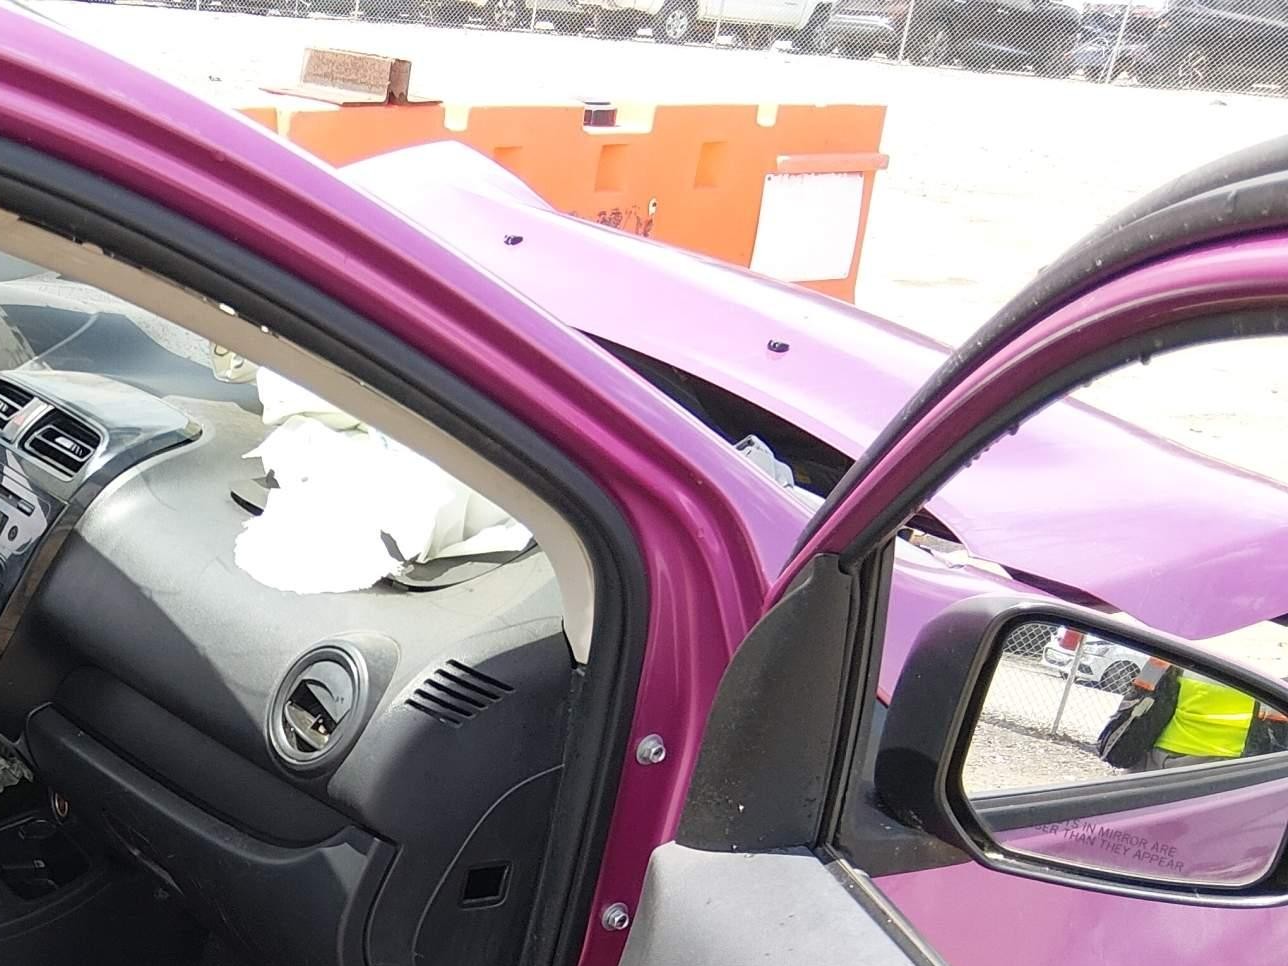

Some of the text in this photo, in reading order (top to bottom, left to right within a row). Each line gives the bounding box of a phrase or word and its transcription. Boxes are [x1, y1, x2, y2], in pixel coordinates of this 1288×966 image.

[1063, 829, 1097, 846] THAN
[1100, 839, 1129, 855] THEY
[1132, 849, 1185, 872] APPEAR
[1083, 821, 1096, 834] IN
[1097, 827, 1148, 848] MIRROR
[1150, 842, 1178, 857] ARE
